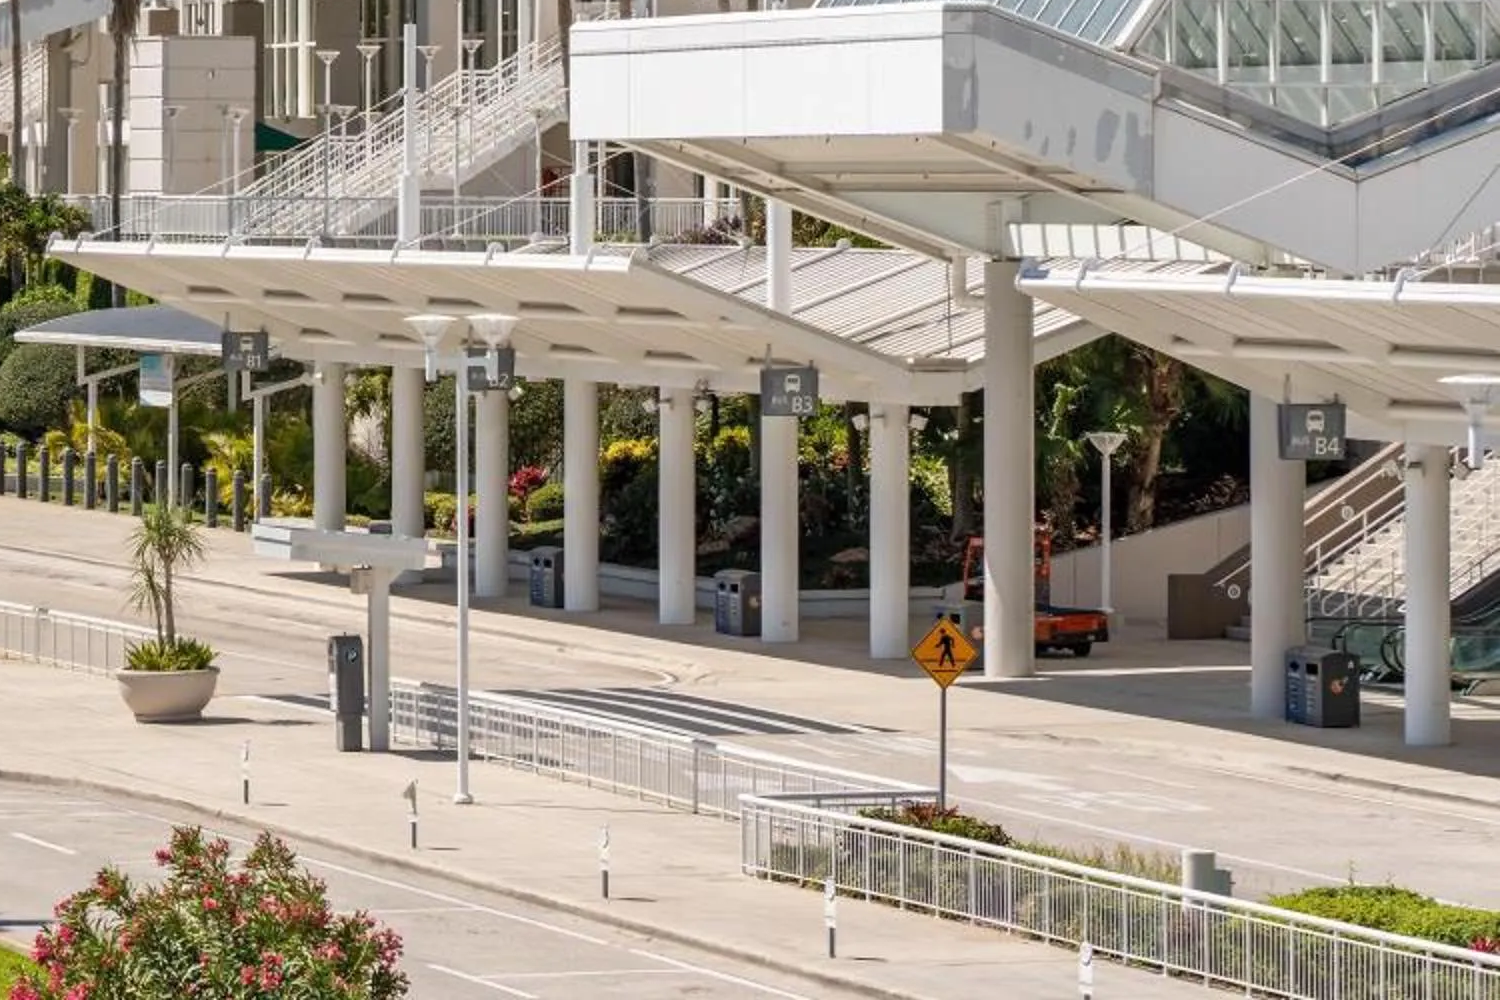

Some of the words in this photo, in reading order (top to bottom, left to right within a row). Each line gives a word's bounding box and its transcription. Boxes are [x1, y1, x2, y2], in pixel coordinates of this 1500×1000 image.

[246, 354, 261, 369] B1
[791, 395, 813, 413] B3
[1315, 436, 1340, 455] B4
